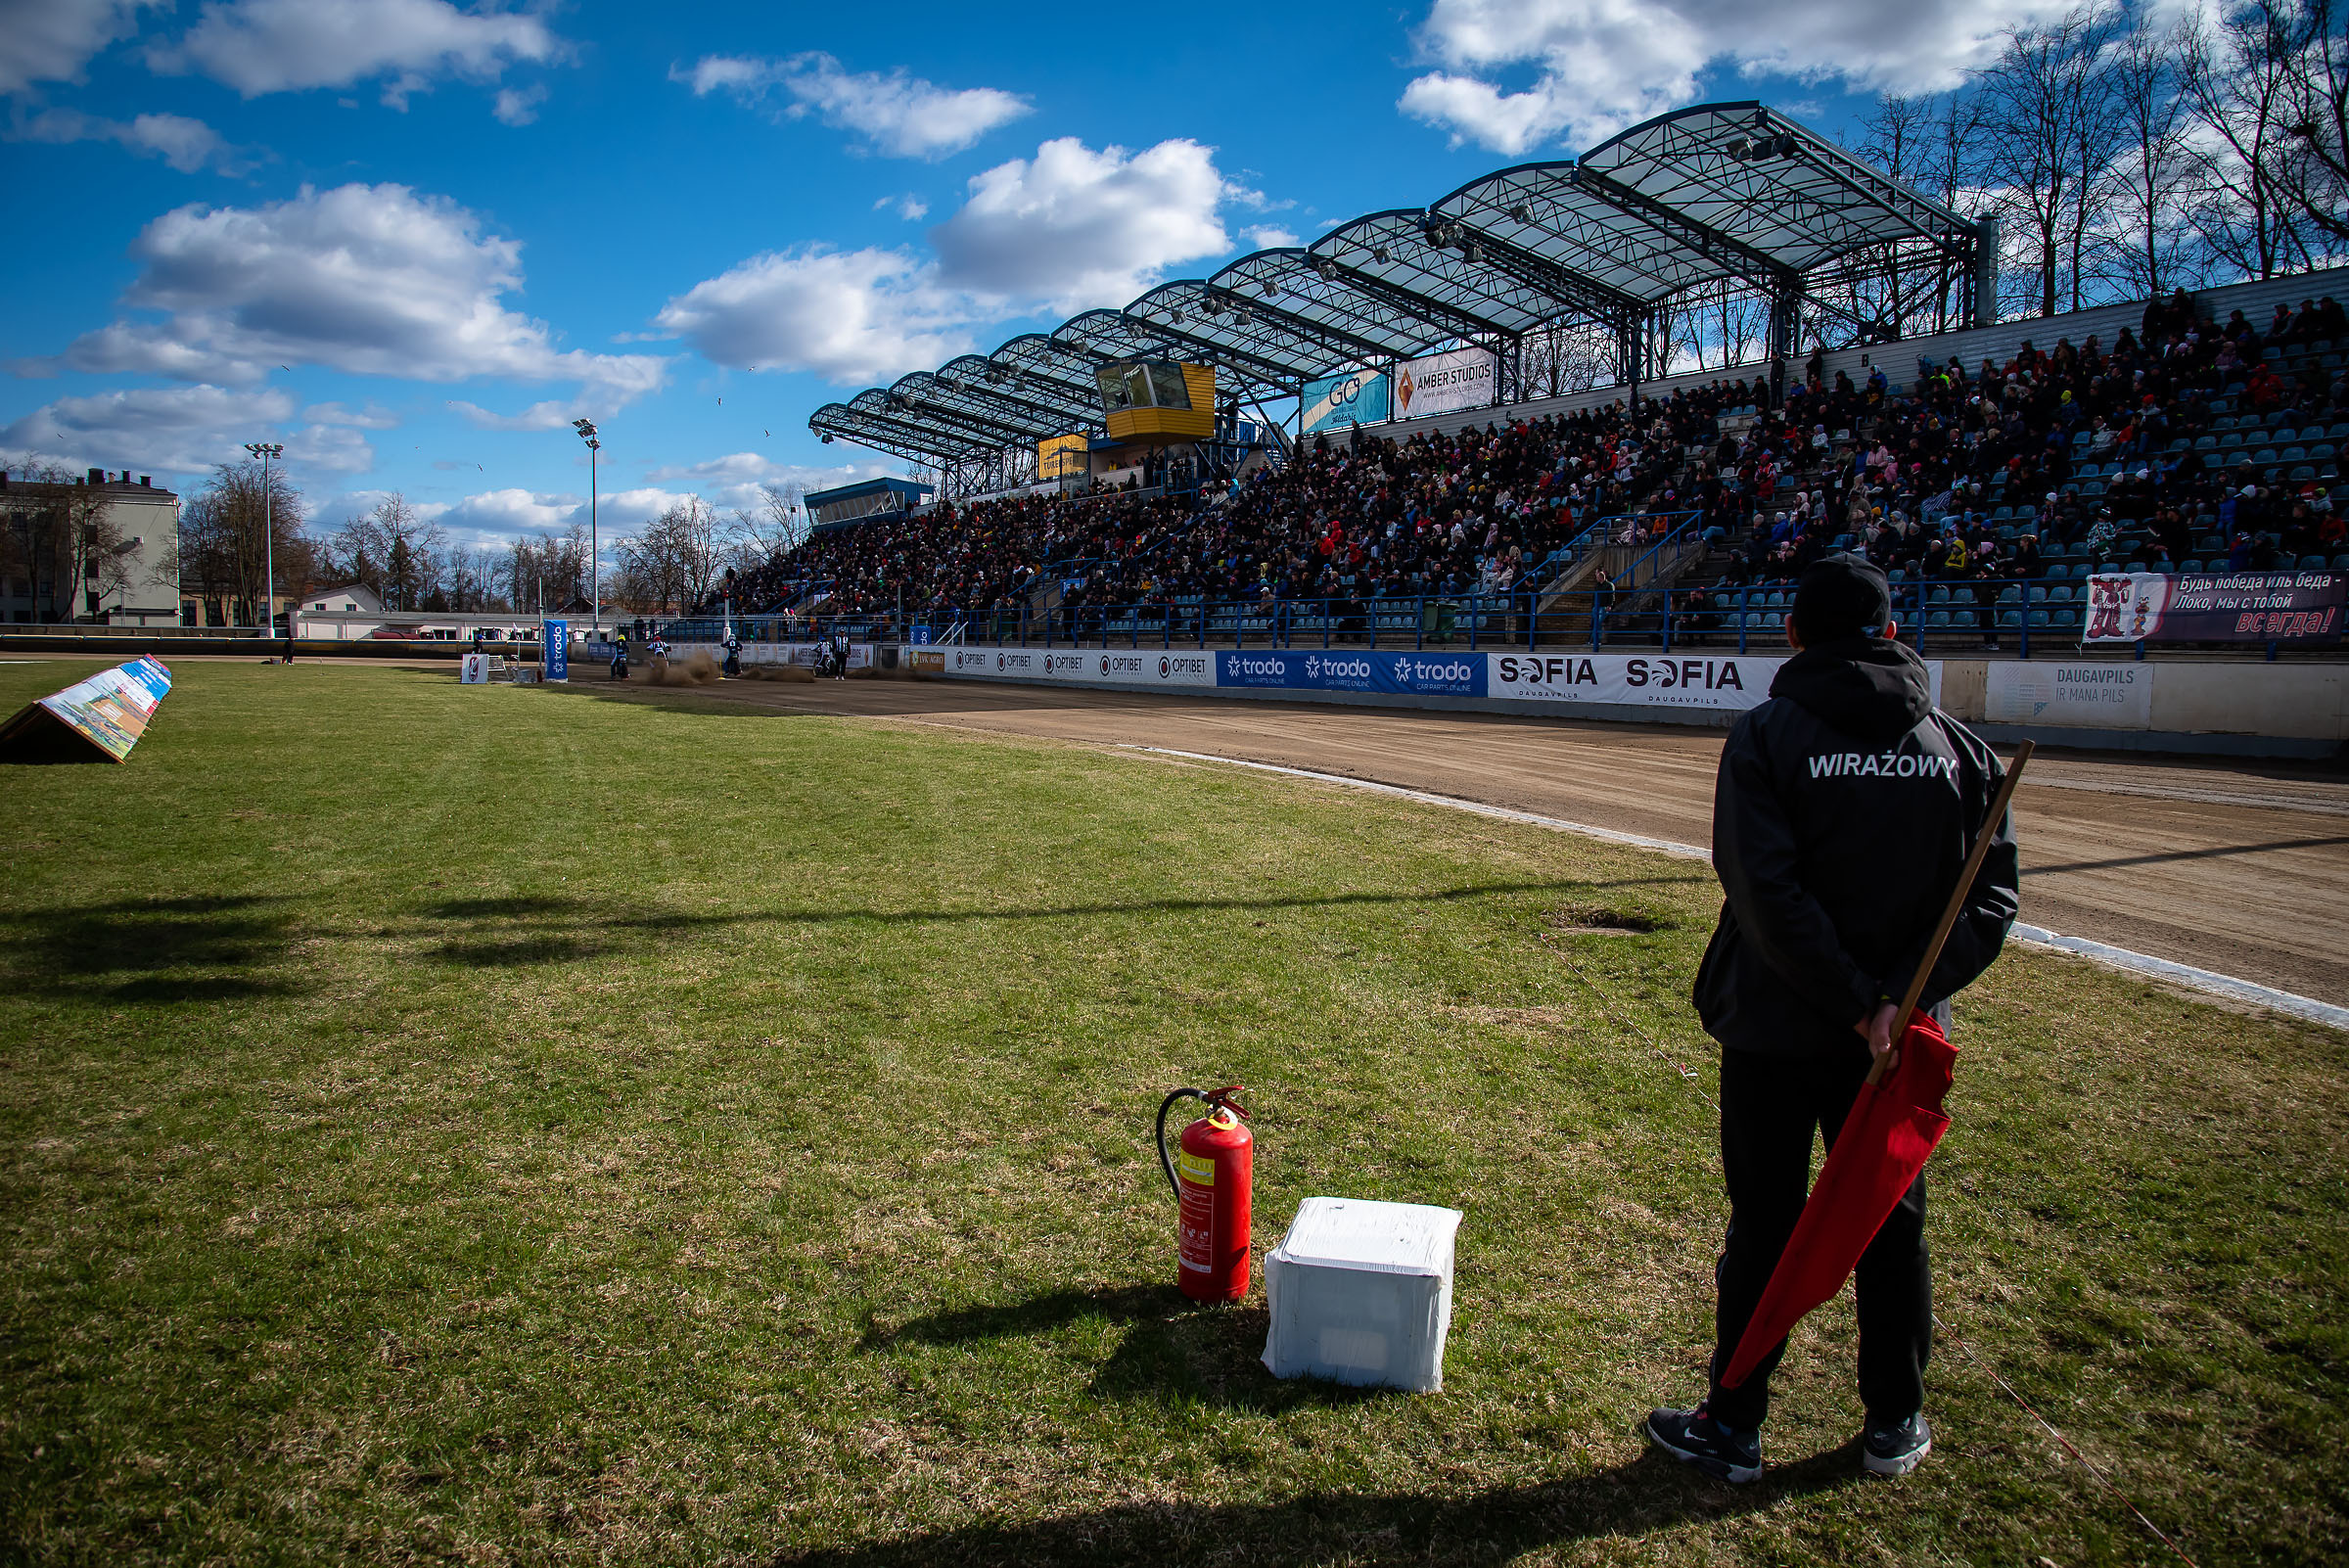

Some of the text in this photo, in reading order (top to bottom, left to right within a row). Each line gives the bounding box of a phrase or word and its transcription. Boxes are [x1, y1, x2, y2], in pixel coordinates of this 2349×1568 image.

[1417, 364, 1491, 391] AMBER STUDIOS
[2179, 576, 2212, 593] Будь
[2214, 574, 2264, 591] победа
[2266, 576, 2292, 588] иль
[2295, 573, 2331, 589] беда
[2175, 593, 2293, 611] Локо, мы с тобой
[2234, 607, 2335, 636] всегда!
[554, 625, 563, 661] trodo
[964, 653, 987, 666] OPTIBET
[1006, 655, 1032, 668] OPTIBET
[1055, 657, 1083, 669] OPTIBET
[1112, 658, 1143, 671] OPTIBET
[1172, 659, 1206, 672] OPTIBET
[1242, 657, 1285, 674] trodo
[1322, 658, 1370, 677] trodo
[1414, 661, 1471, 680] trodo
[1499, 658, 1598, 685] SOFIA
[1626, 659, 1744, 690] SOFIA
[2057, 669, 2134, 683] DAUGAVPILS
[1518, 690, 1578, 699] DAUGAVPILS
[1648, 695, 1719, 705] DAUGAVPILS
[2055, 687, 2125, 703] IR MANA PILS
[1809, 749, 1958, 779] WIRAŻOWY
